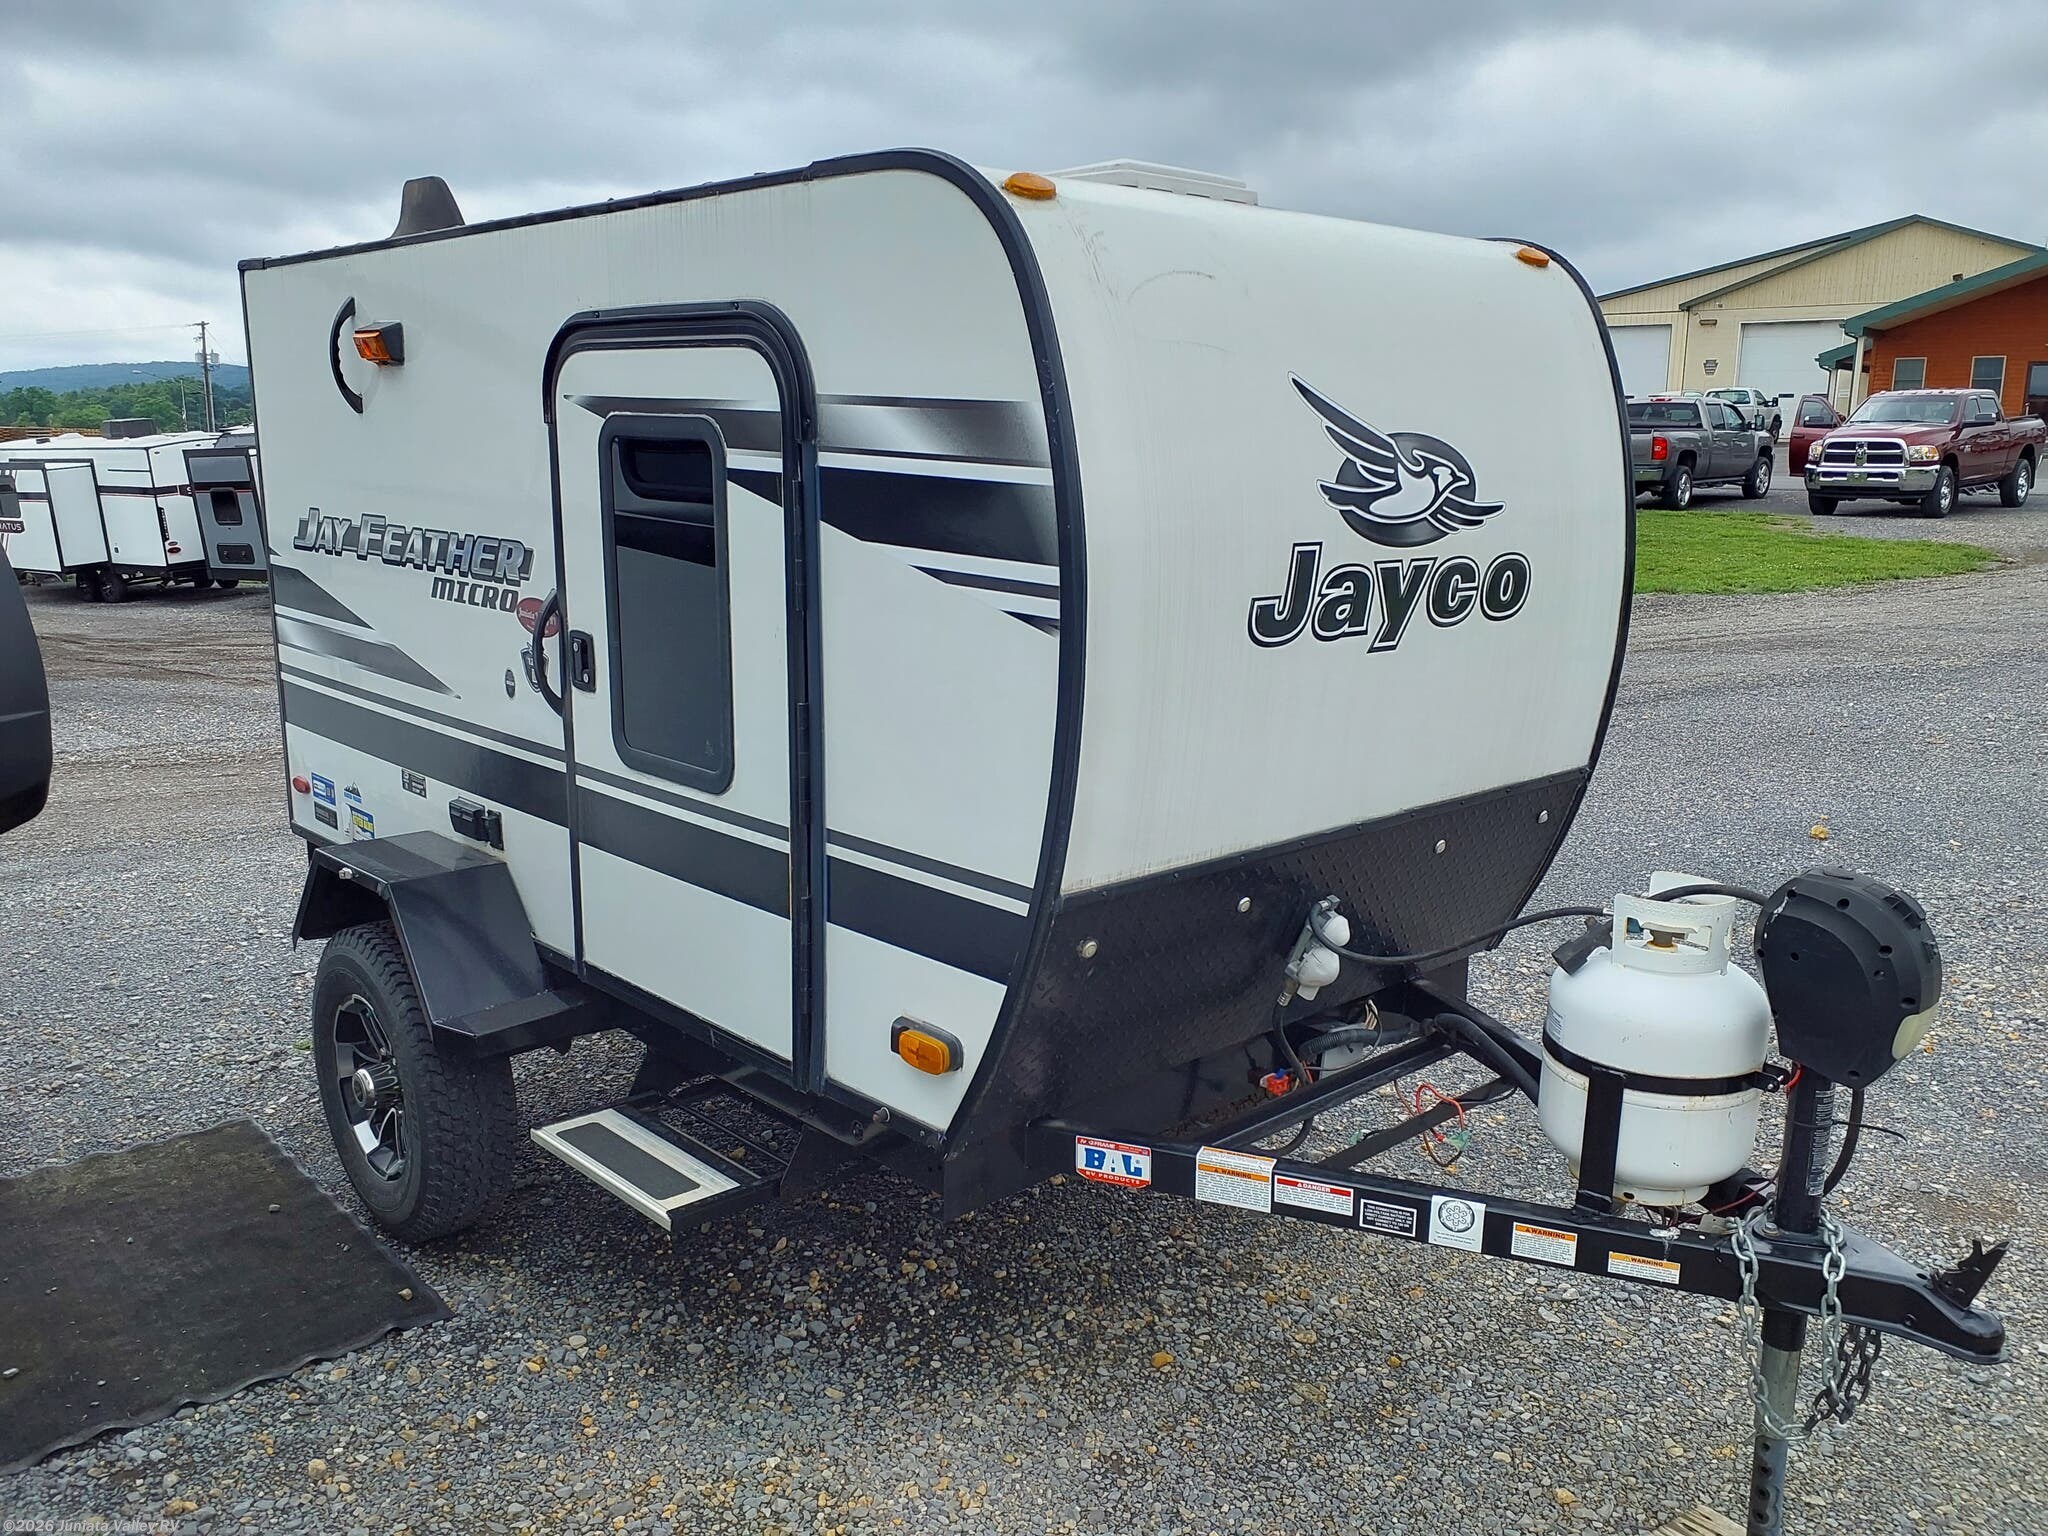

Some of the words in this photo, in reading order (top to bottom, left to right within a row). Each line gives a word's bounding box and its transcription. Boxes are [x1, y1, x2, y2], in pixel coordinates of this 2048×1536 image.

[294, 508, 351, 555] JAY
[356, 513, 527, 587] FEATHER
[431, 577, 520, 613] MICRO
[1248, 541, 1532, 654] Jayco
[1085, 1148, 1142, 1177] BAL
[1098, 1173, 1140, 1185] PRODUCTS
[1221, 1169, 1252, 1179] WARNING
[1302, 1183, 1331, 1193] DANGER
[1531, 1228, 1566, 1239] WARNING
[1631, 1257, 1664, 1267] WARNING
